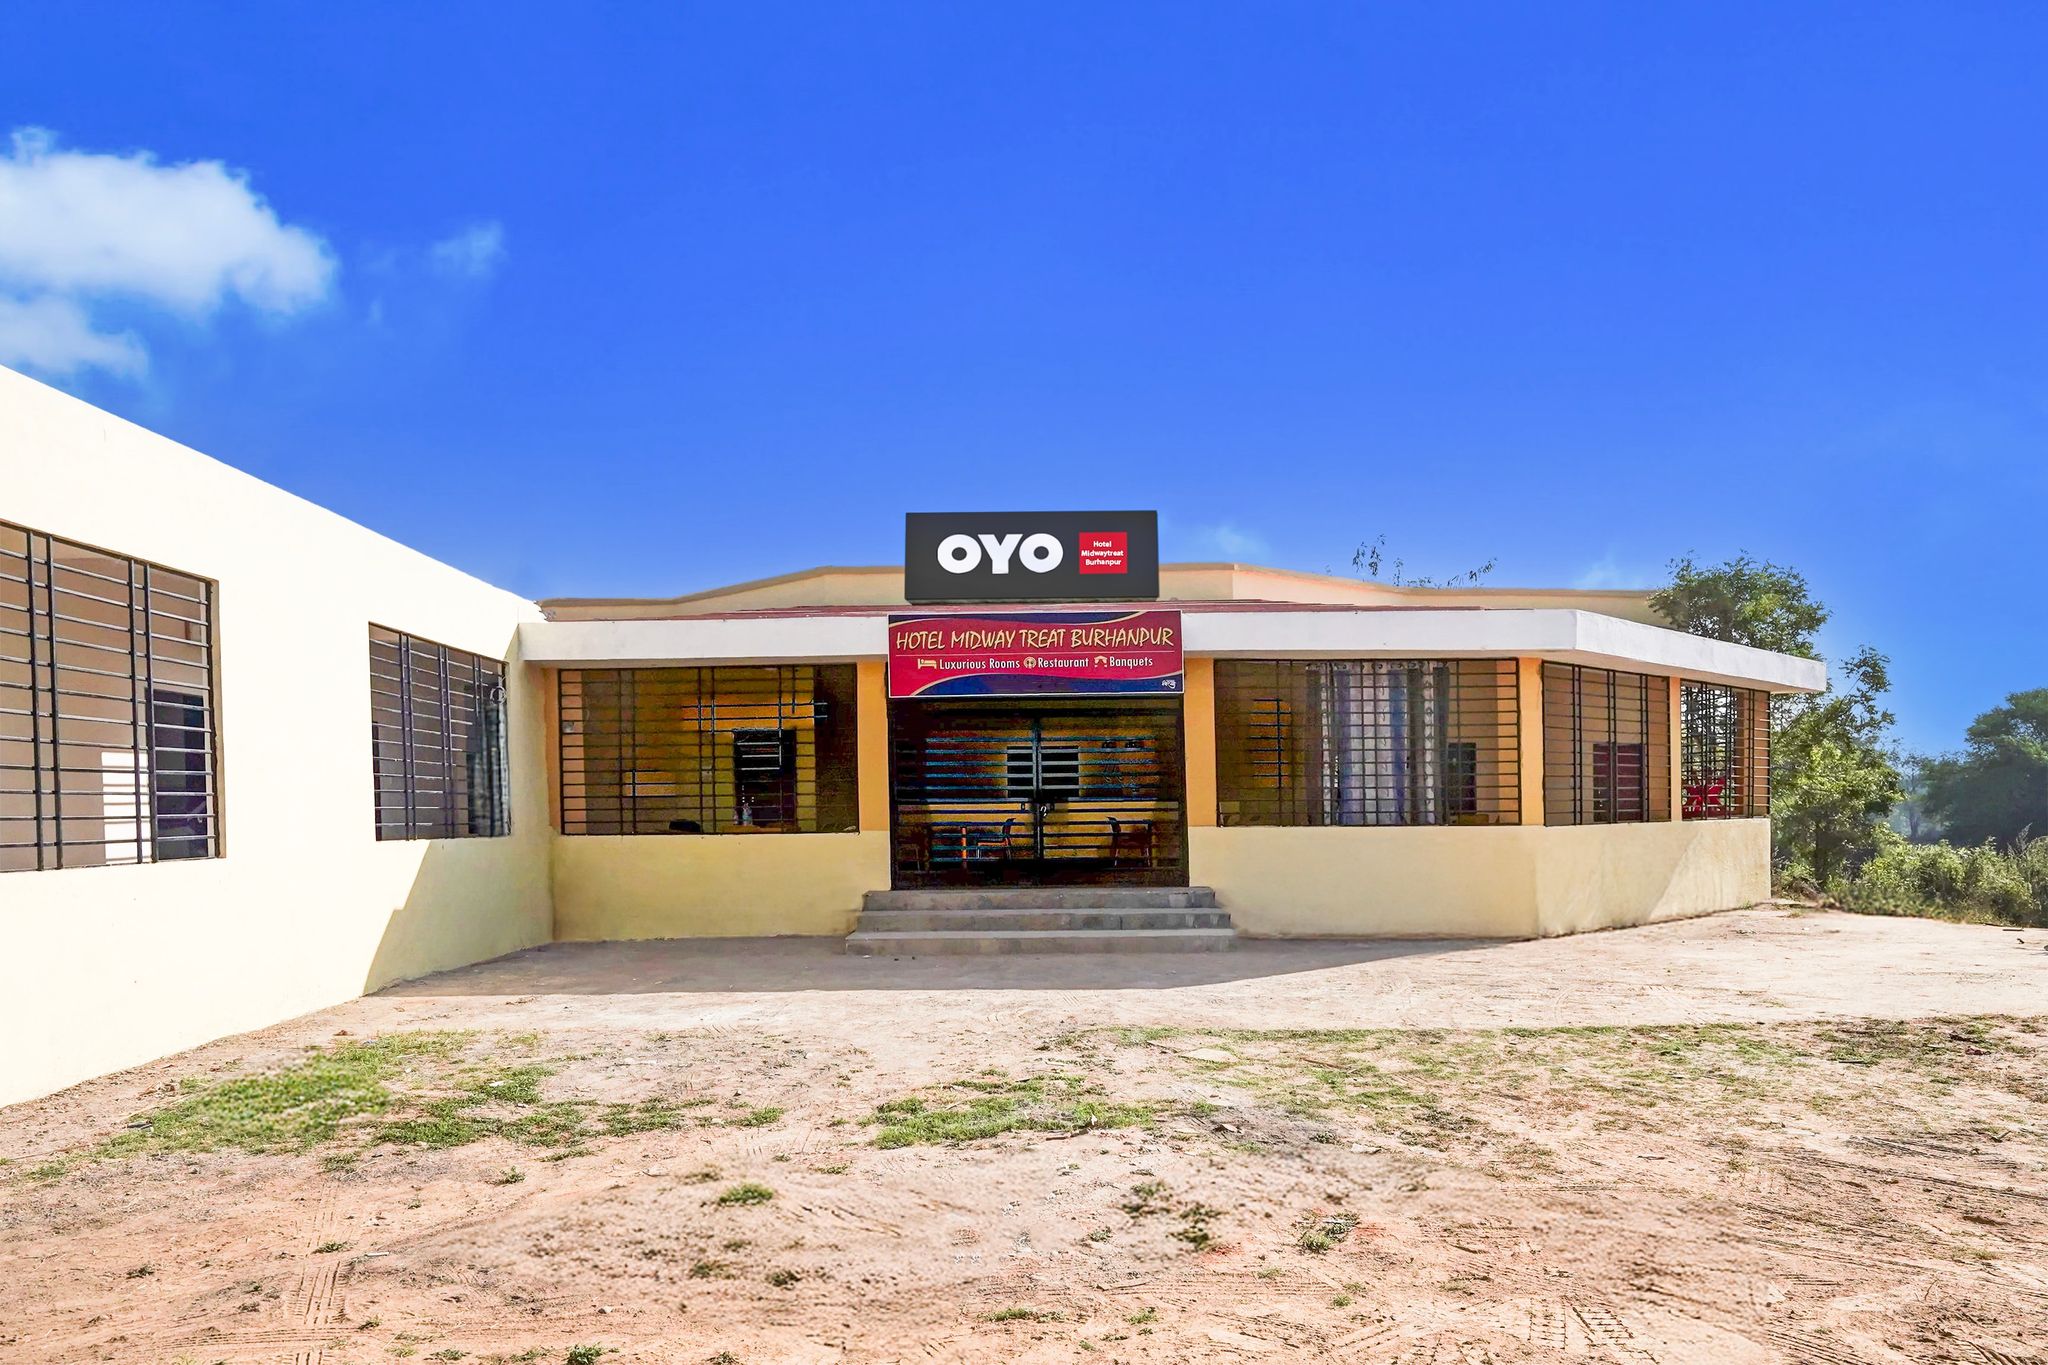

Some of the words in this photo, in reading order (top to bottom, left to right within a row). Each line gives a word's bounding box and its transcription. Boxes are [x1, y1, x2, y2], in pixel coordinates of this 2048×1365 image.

[937, 533, 1063, 574] OYO
[1081, 550, 1124, 558] Midwaytreat
[1085, 559, 1122, 567] Burhanpur
[896, 630, 945, 650] HOTEL
[951, 629, 1016, 650] MIDWAY
[1019, 629, 1066, 648] TREAT
[1071, 627, 1174, 648] BURHANPUR
[940, 659, 986, 670] Luxurious
[989, 658, 1020, 669] Rooms
[1038, 657, 1089, 668] Restaurant
[1109, 656, 1153, 669] Banquets
